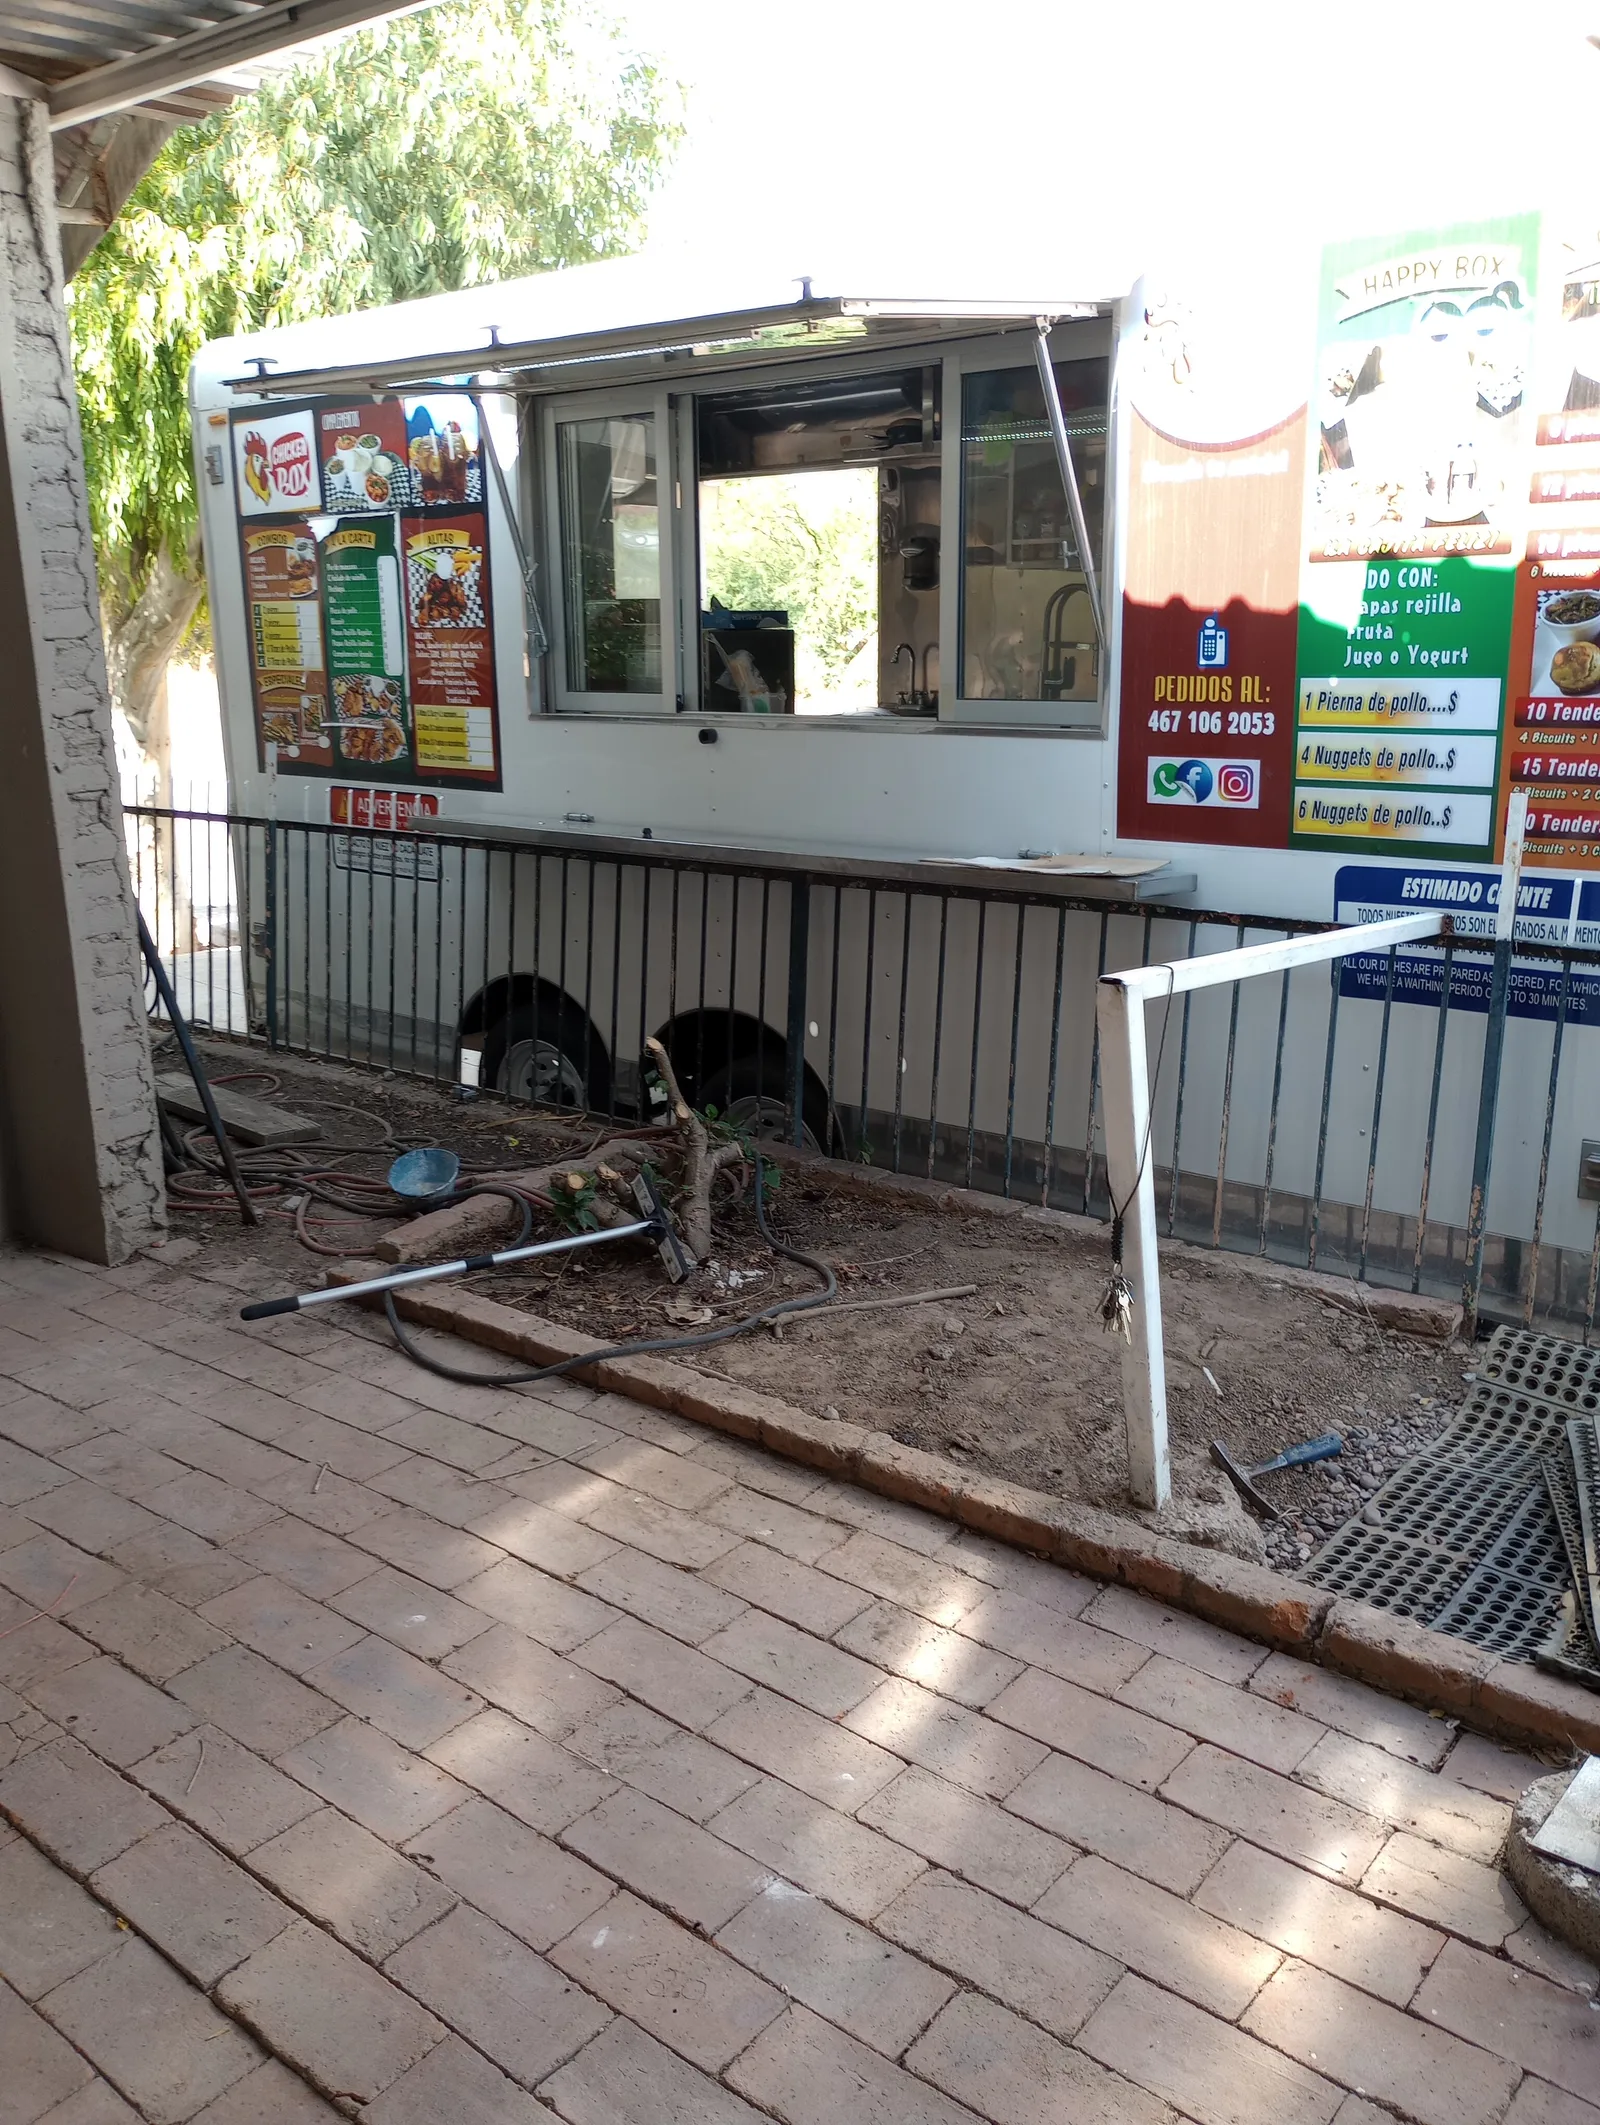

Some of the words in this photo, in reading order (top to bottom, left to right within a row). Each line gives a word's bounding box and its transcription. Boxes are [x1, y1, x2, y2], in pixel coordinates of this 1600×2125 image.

[1364, 259, 1442, 295] HAPPY
[1455, 256, 1506, 279] BOX
[272, 437, 308, 465] CHICKEN
[275, 461, 311, 495] BOX
[427, 532, 455, 545] ALITAS
[1397, 566, 1439, 588] CON:
[1530, 565, 1539, 578] 6
[1359, 599, 1399, 617] apas
[1406, 592, 1462, 616] rejilla
[1346, 623, 1393, 640] Fruta
[1343, 645, 1383, 669] Jugo
[1389, 650, 1399, 665] o
[1407, 644, 1469, 668] Yogurt
[1154, 675, 1233, 702] PEDIDOS
[1240, 676, 1271, 703] AL:
[1305, 692, 1312, 711] 1
[1317, 691, 1363, 712] Pierna
[1368, 692, 1387, 712] de
[1148, 710, 1182, 733] 467
[1188, 711, 1221, 734] 106
[1227, 711, 1275, 735] 2053
[1526, 702, 1547, 722] 10
[1519, 732, 1528, 744] 4
[1532, 732, 1577, 745] Biscuits
[1592, 733, 1598, 745] 1
[1301, 745, 1311, 764] 4
[1314, 746, 1372, 770] Nuggets
[1376, 748, 1394, 767] de
[1522, 757, 1542, 777] 15
[1524, 786, 1567, 800] Biscuits
[1582, 788, 1592, 801] 2
[357, 797, 432, 817] ADVERENCIA
[1298, 800, 1307, 819] 6
[1311, 801, 1369, 825] Nuggets
[1373, 804, 1390, 823] de
[1525, 813, 1536, 831] 0
[1522, 841, 1565, 856] Biscuits
[1580, 844, 1589, 856] 3
[1401, 877, 1483, 904] ESTIMADO
[1487, 883, 1553, 909] CNTE
[1358, 908, 1384, 923] TODOS
[1469, 916, 1486, 934] SON
[1488, 918, 1546, 940] ELRADOS
[1548, 924, 1559, 941] AL
[1562, 925, 1600, 943] MMENT
[1342, 957, 1357, 969] ALL
[1358, 957, 1378, 970] OUR
[1380, 959, 1412, 974] DIHES
[1412, 963, 1431, 976] ARE
[1433, 965, 1480, 982] PRPARED
[1482, 971, 1493, 984] AS
[1507, 974, 1547, 992] RDERED,
[1549, 979, 1570, 993] FO
[1572, 981, 1600, 996] WHIC
[1357, 973, 1371, 985] WE
[1395, 976, 1403, 988] A
[1449, 983, 1482, 998] PERIOD
[1513, 990, 1527, 1003] TO
[1528, 993, 1540, 1005] 30
[1542, 994, 1588, 1011] MINTES.
